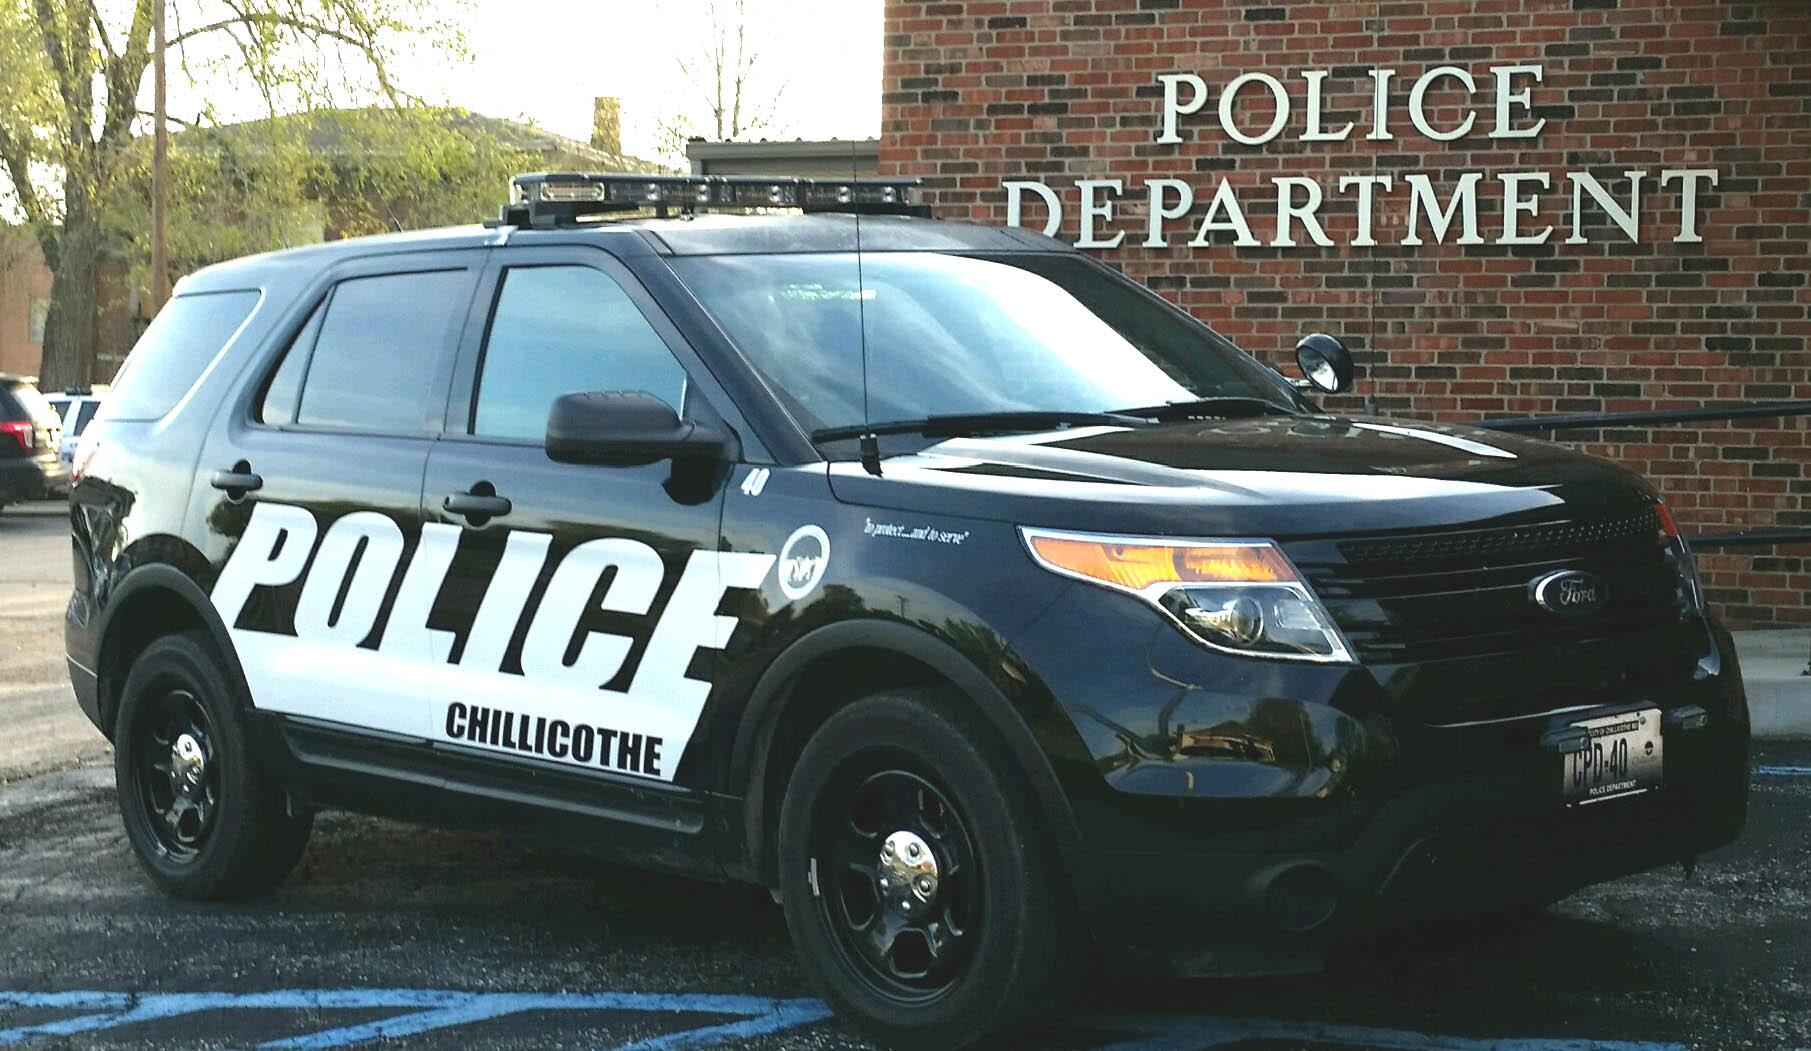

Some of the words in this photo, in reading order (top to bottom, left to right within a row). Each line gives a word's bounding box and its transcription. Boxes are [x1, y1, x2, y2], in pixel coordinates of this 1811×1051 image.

[1156, 64, 1547, 145] POLICE
[1001, 167, 1719, 249] DEPARTMENT
[741, 468, 770, 496] 40
[209, 501, 777, 702] POLICE
[1560, 578, 1597, 605] Ford
[445, 702, 663, 776] CHILLICOTHE
